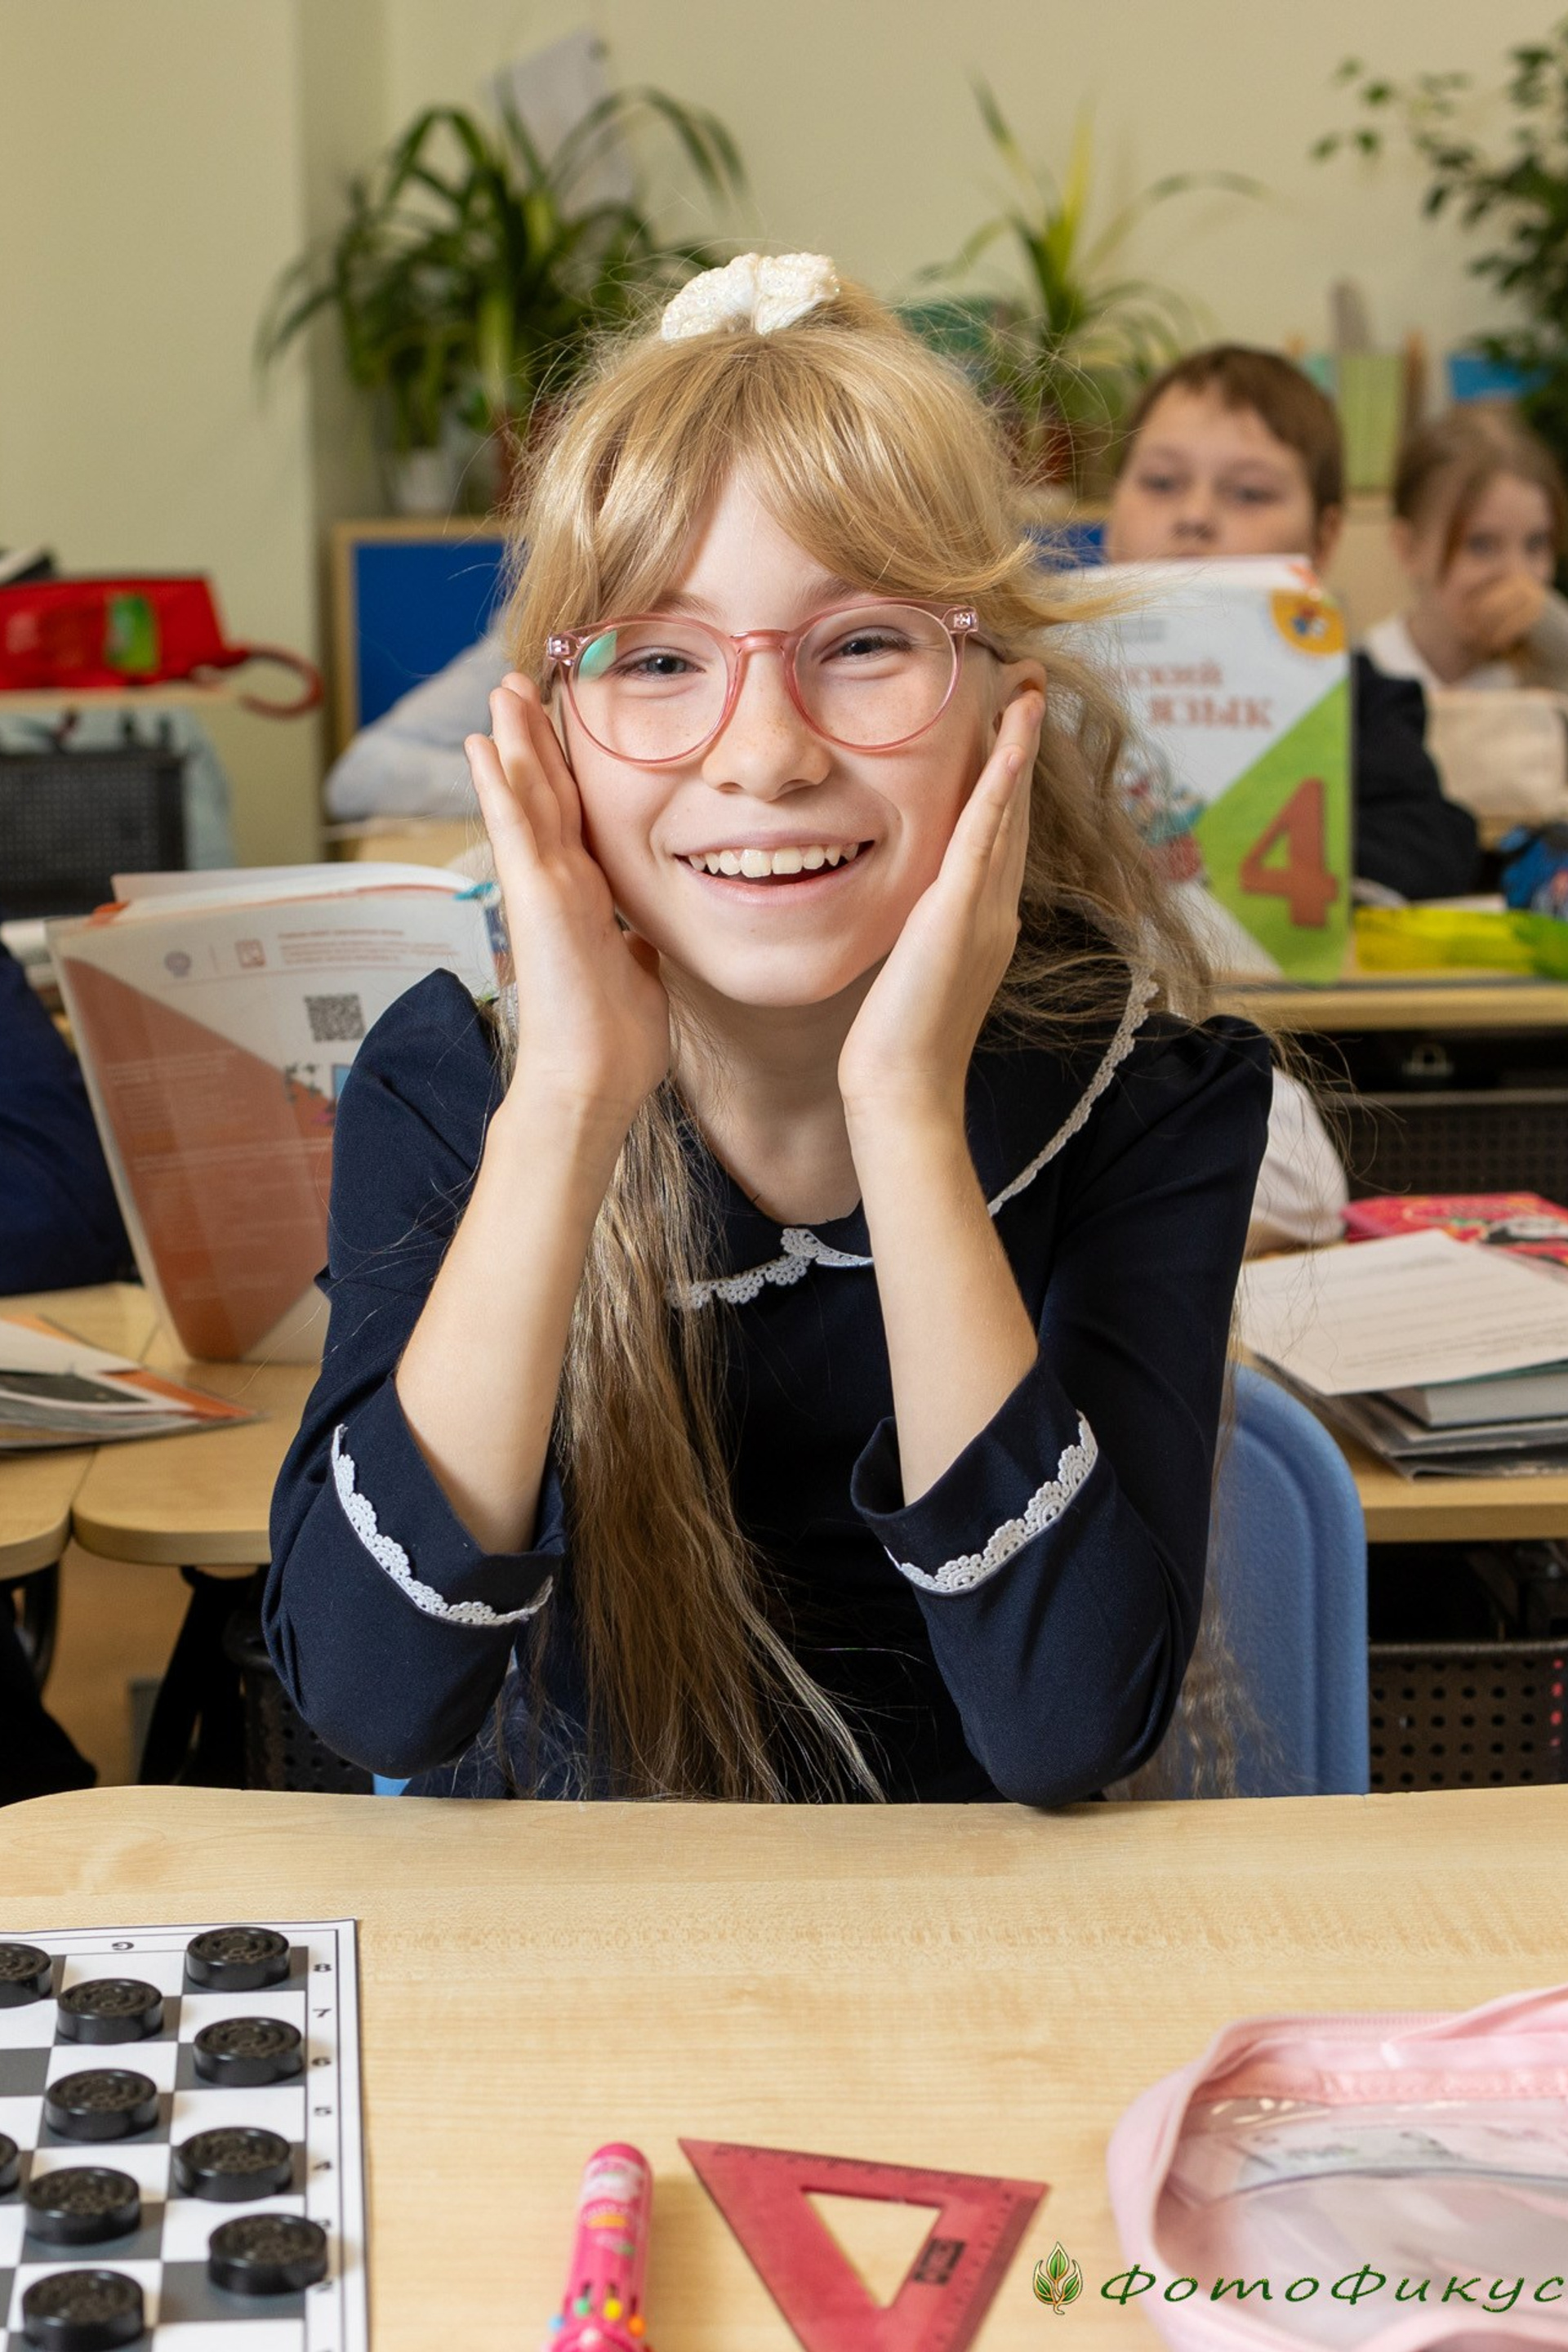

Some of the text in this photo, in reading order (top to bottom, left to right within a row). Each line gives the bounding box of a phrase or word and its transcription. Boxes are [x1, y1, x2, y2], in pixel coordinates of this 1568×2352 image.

[1240, 777, 1339, 929] 4
[313, 1962, 332, 1973] 8
[312, 2007, 332, 2019] 7
[311, 2056, 332, 2067] 6
[313, 2105, 332, 2117] 5
